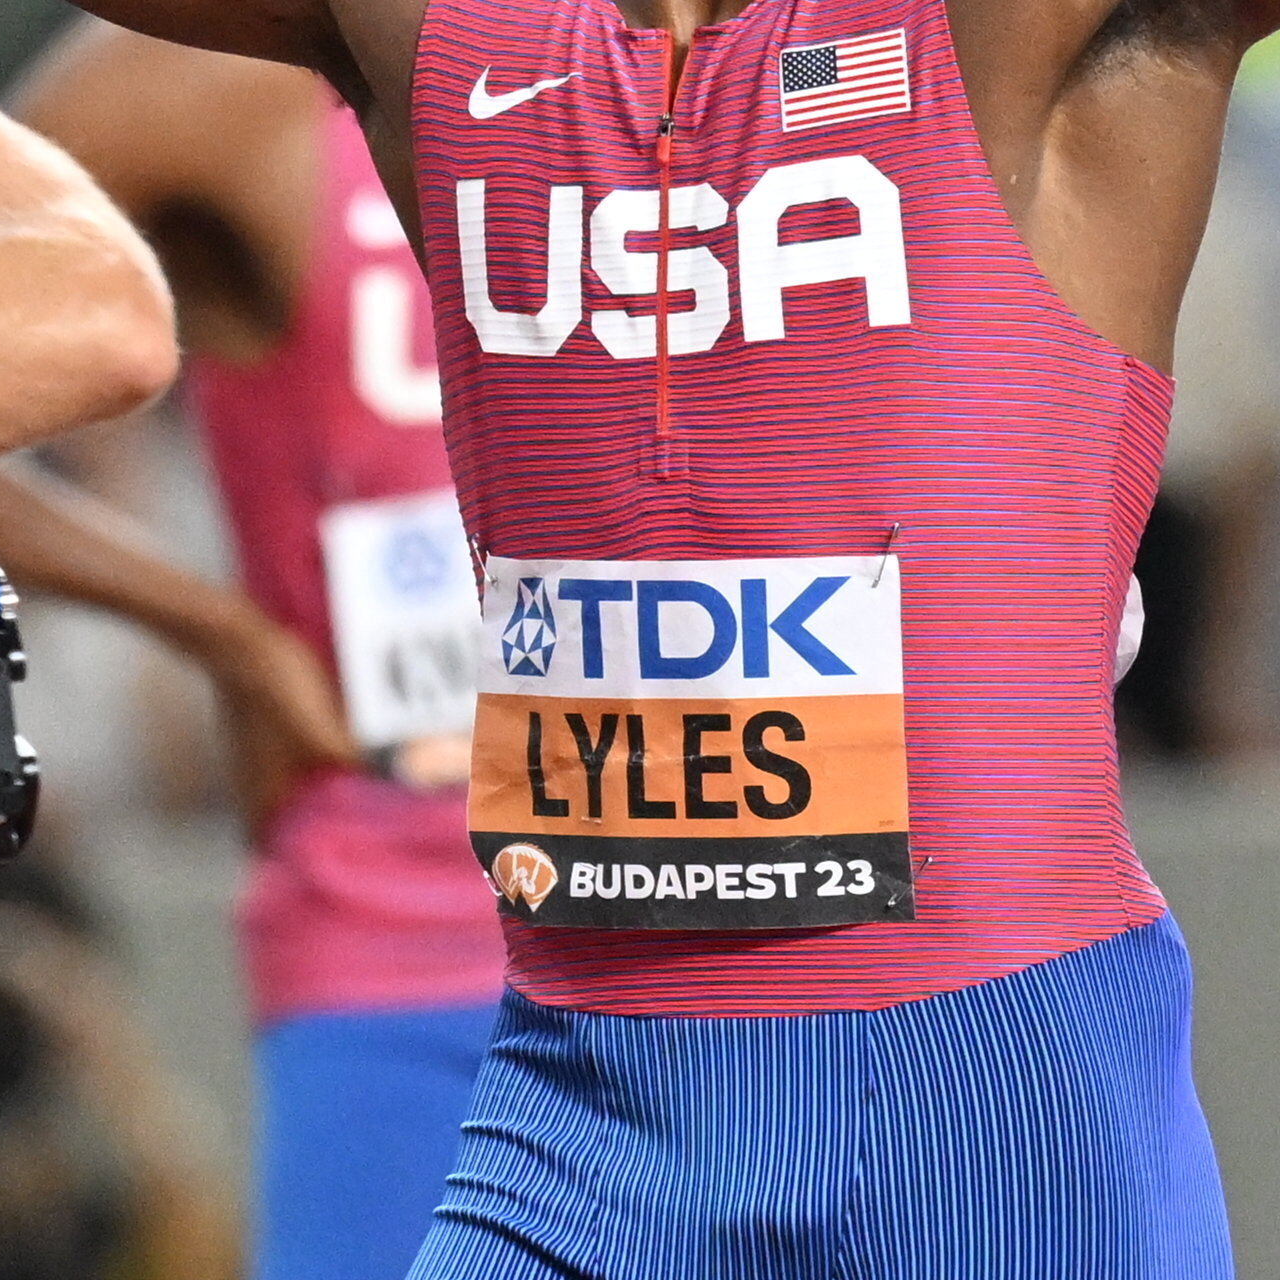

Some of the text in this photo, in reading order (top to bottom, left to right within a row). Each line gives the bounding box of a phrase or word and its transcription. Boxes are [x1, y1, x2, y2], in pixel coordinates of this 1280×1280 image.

[455, 154, 912, 360] USA
[557, 575, 858, 679] TDK
[527, 710, 812, 819] LYLES
[570, 858, 876, 900] BUDAPEST 23
